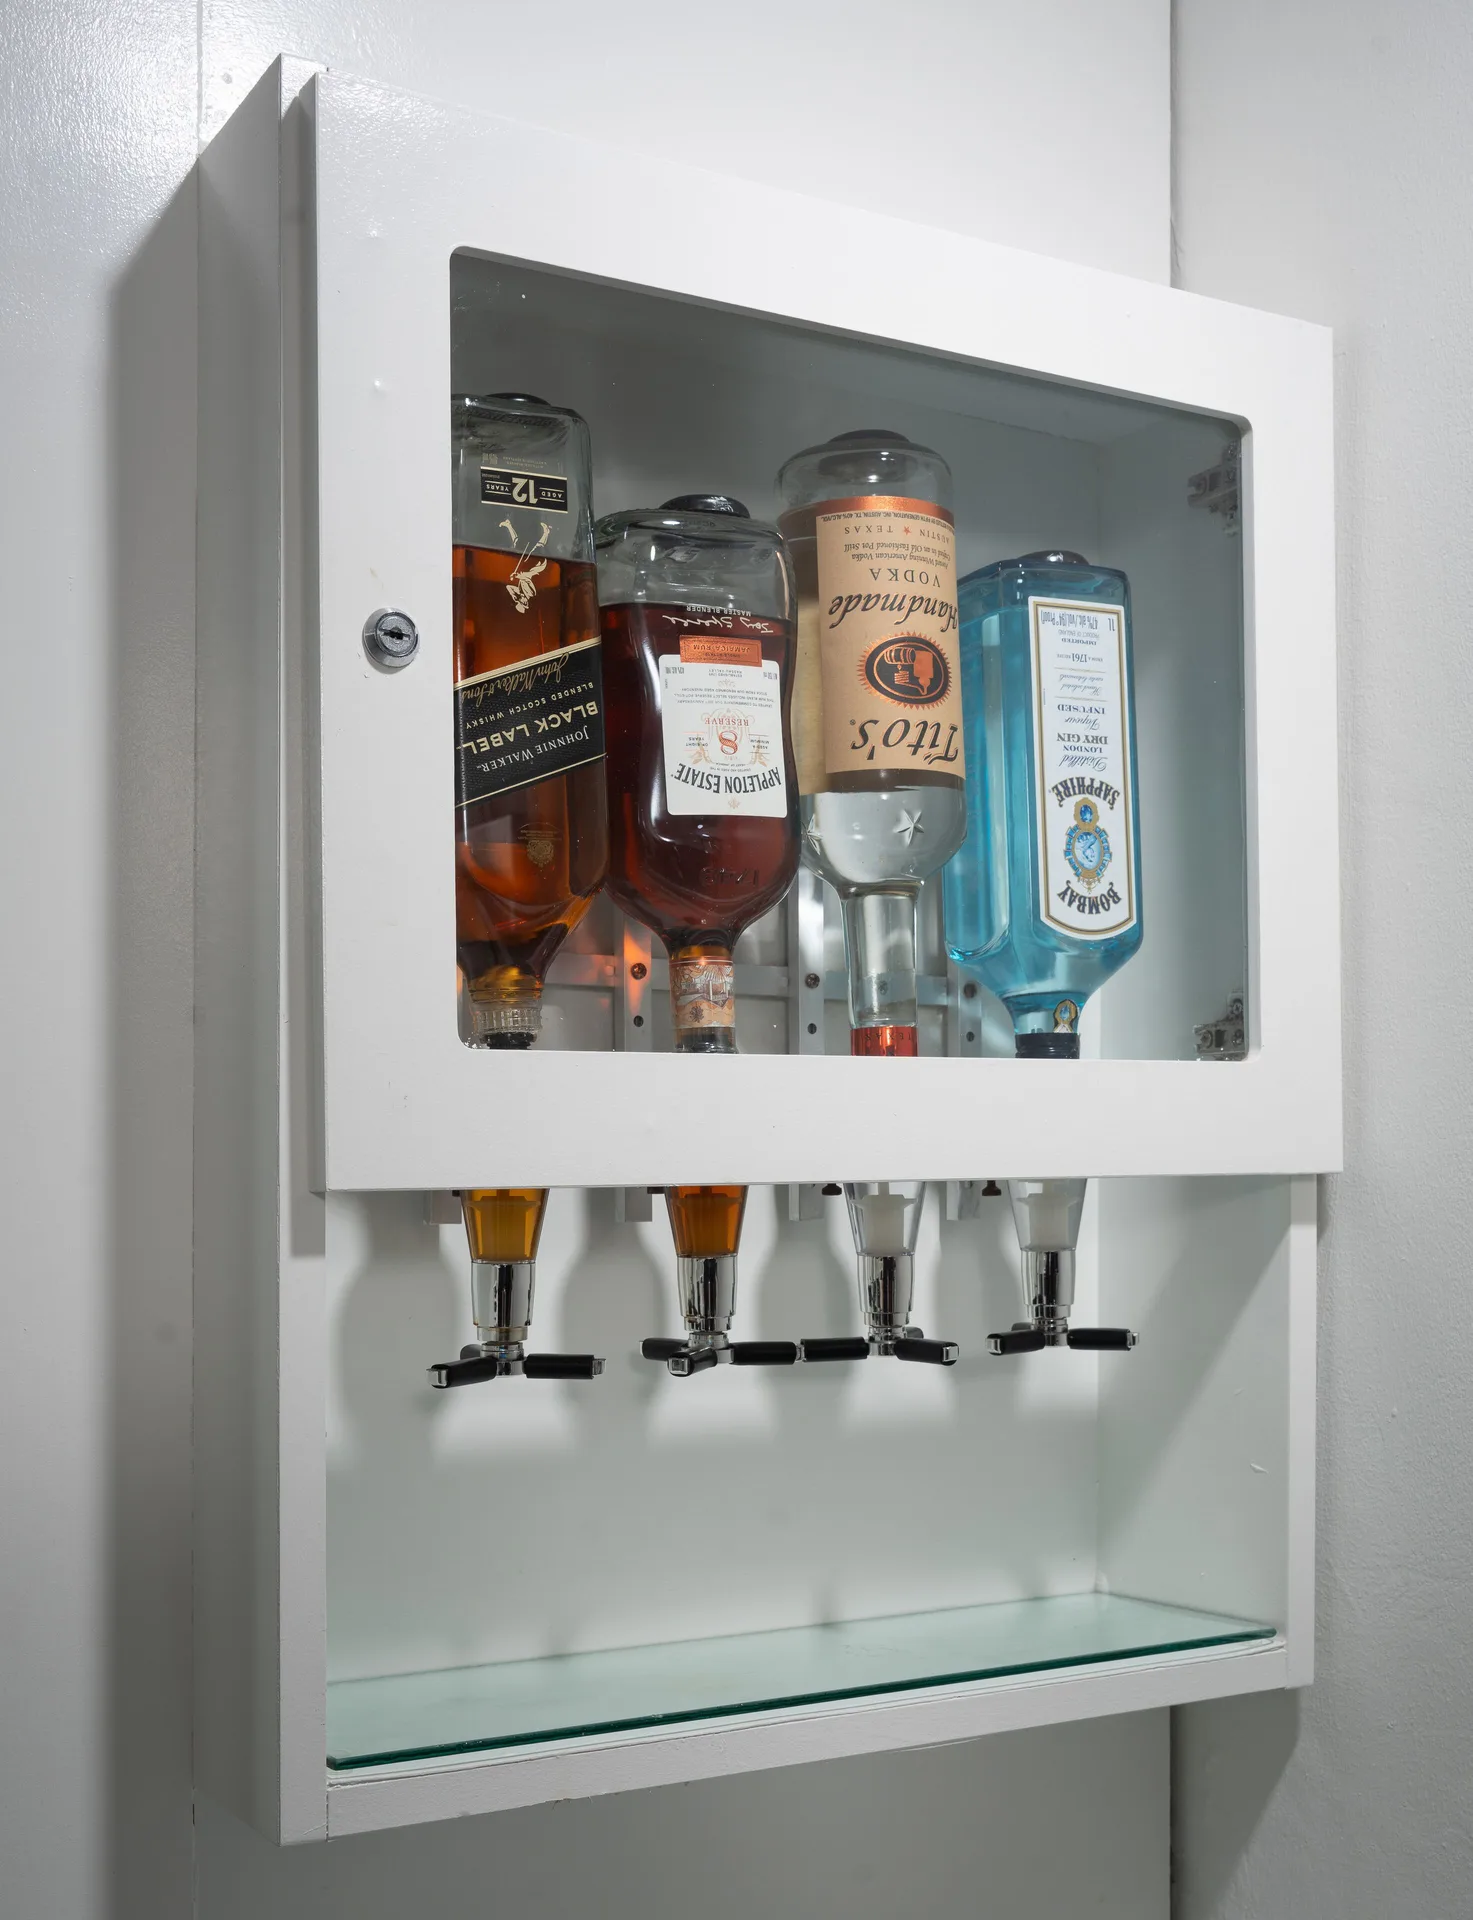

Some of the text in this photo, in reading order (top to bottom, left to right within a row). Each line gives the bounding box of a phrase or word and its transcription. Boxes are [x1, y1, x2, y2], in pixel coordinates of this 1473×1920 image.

[485, 483, 509, 492] YEARS
[511, 477, 538, 504] 12
[843, 525, 893, 535] TEXAS
[919, 529, 950, 544] AUSTIN
[843, 543, 860, 553] Still
[875, 542, 909, 551] Fashioned
[910, 544, 923, 554] Old
[851, 552, 948, 570] Award Winning American Vodka
[937, 549, 950, 561] Crafted
[868, 568, 940, 588] VODKA
[685, 605, 751, 617] MASTER BLENDER
[827, 593, 958, 633] Handmade
[1087, 615, 1098, 630] 47%
[1057, 629, 1076, 637] ENGLAND
[1061, 637, 1097, 646] IMPORTED
[1071, 653, 1088, 663] 1761
[535, 652, 569, 685] John
[494, 667, 538, 696] Walker
[1060, 683, 1101, 697] Hand selected
[464, 682, 594, 729] BLENDED SCOTCH WHISKY
[1057, 703, 1105, 715] INFUSED
[461, 701, 598, 754] BLACK LABEL
[703, 717, 749, 726] RESERVE
[1064, 714, 1100, 731] Vapour
[718, 731, 738, 755] 8
[850, 719, 959, 765] Tito's
[1056, 732, 1108, 745] DRY GIN
[479, 725, 589, 772] JOHNNIE WALKER
[1062, 745, 1103, 754] LONDON
[1058, 754, 1108, 772] Distilled
[672, 763, 782, 794] APPLETON ESTATE
[1051, 777, 1120, 811] SAPPHIRE
[1056, 880, 1122, 915] BOMBAY
[864, 1032, 911, 1041] TEXAS
